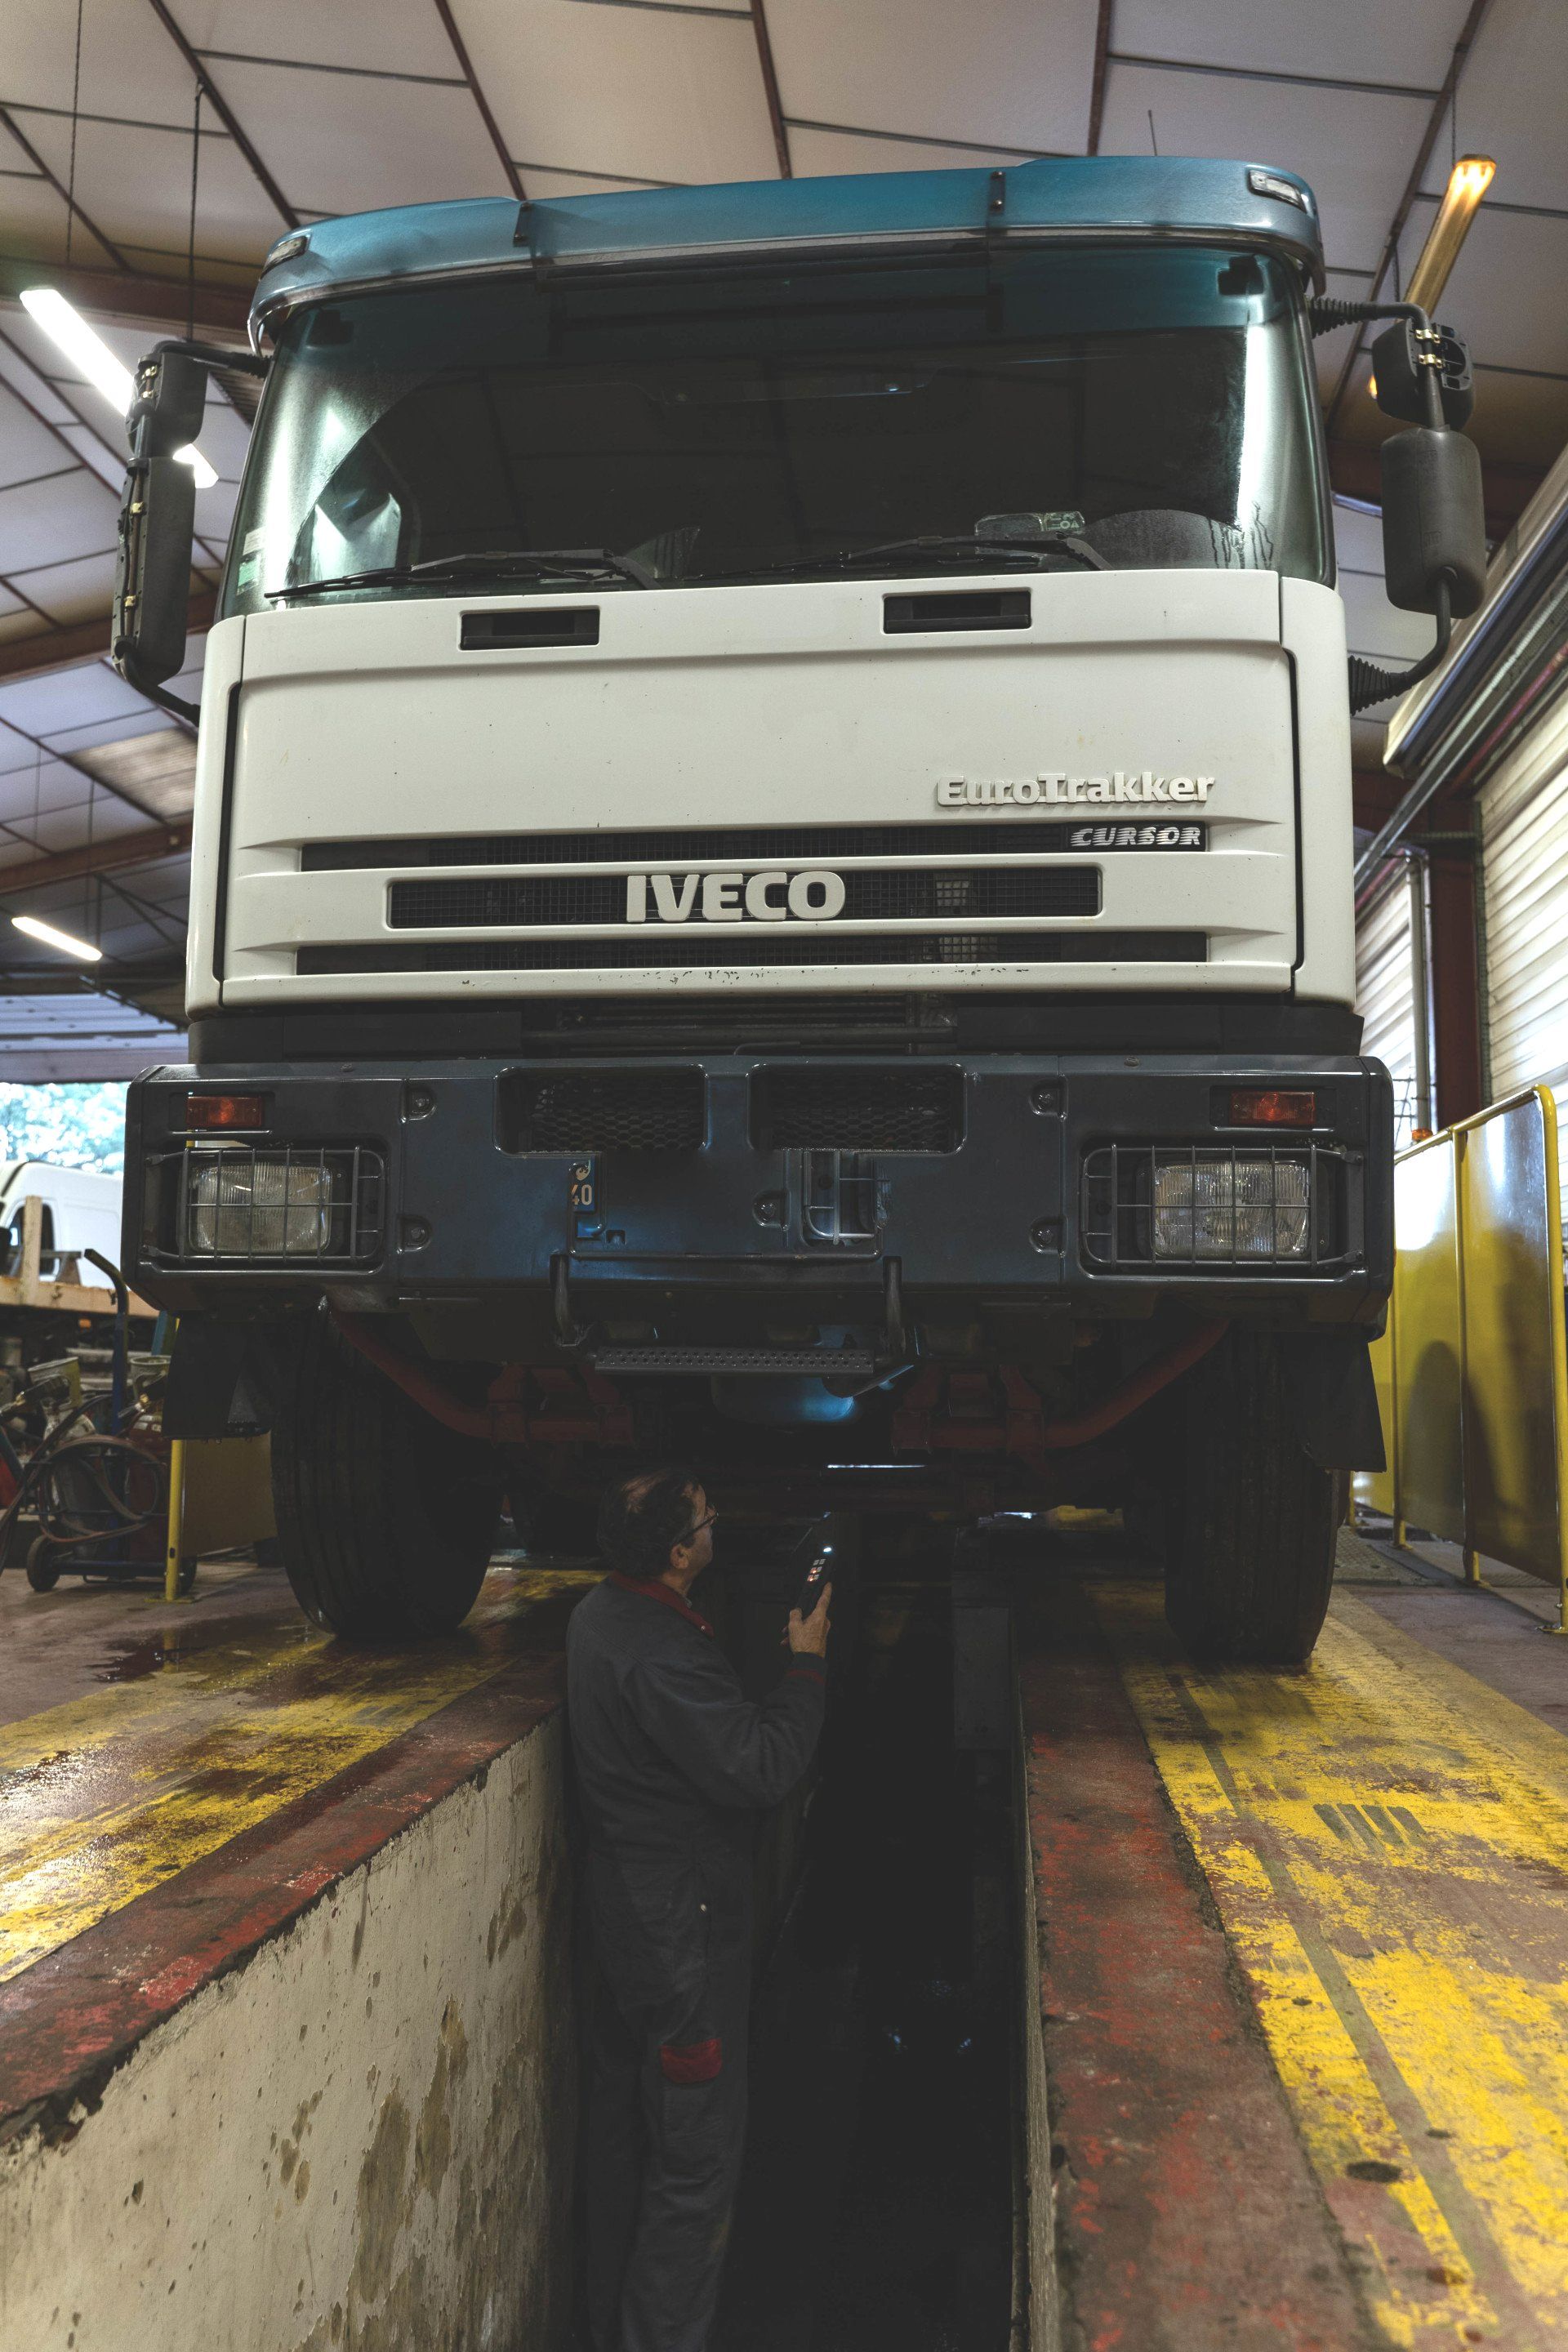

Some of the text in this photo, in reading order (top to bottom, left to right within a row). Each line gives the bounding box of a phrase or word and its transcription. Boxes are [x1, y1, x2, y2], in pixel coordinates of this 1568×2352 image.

[938, 772, 1215, 806] EuroTrakker
[1069, 826, 1200, 846] CURSOR
[626, 871, 846, 923] IVECO
